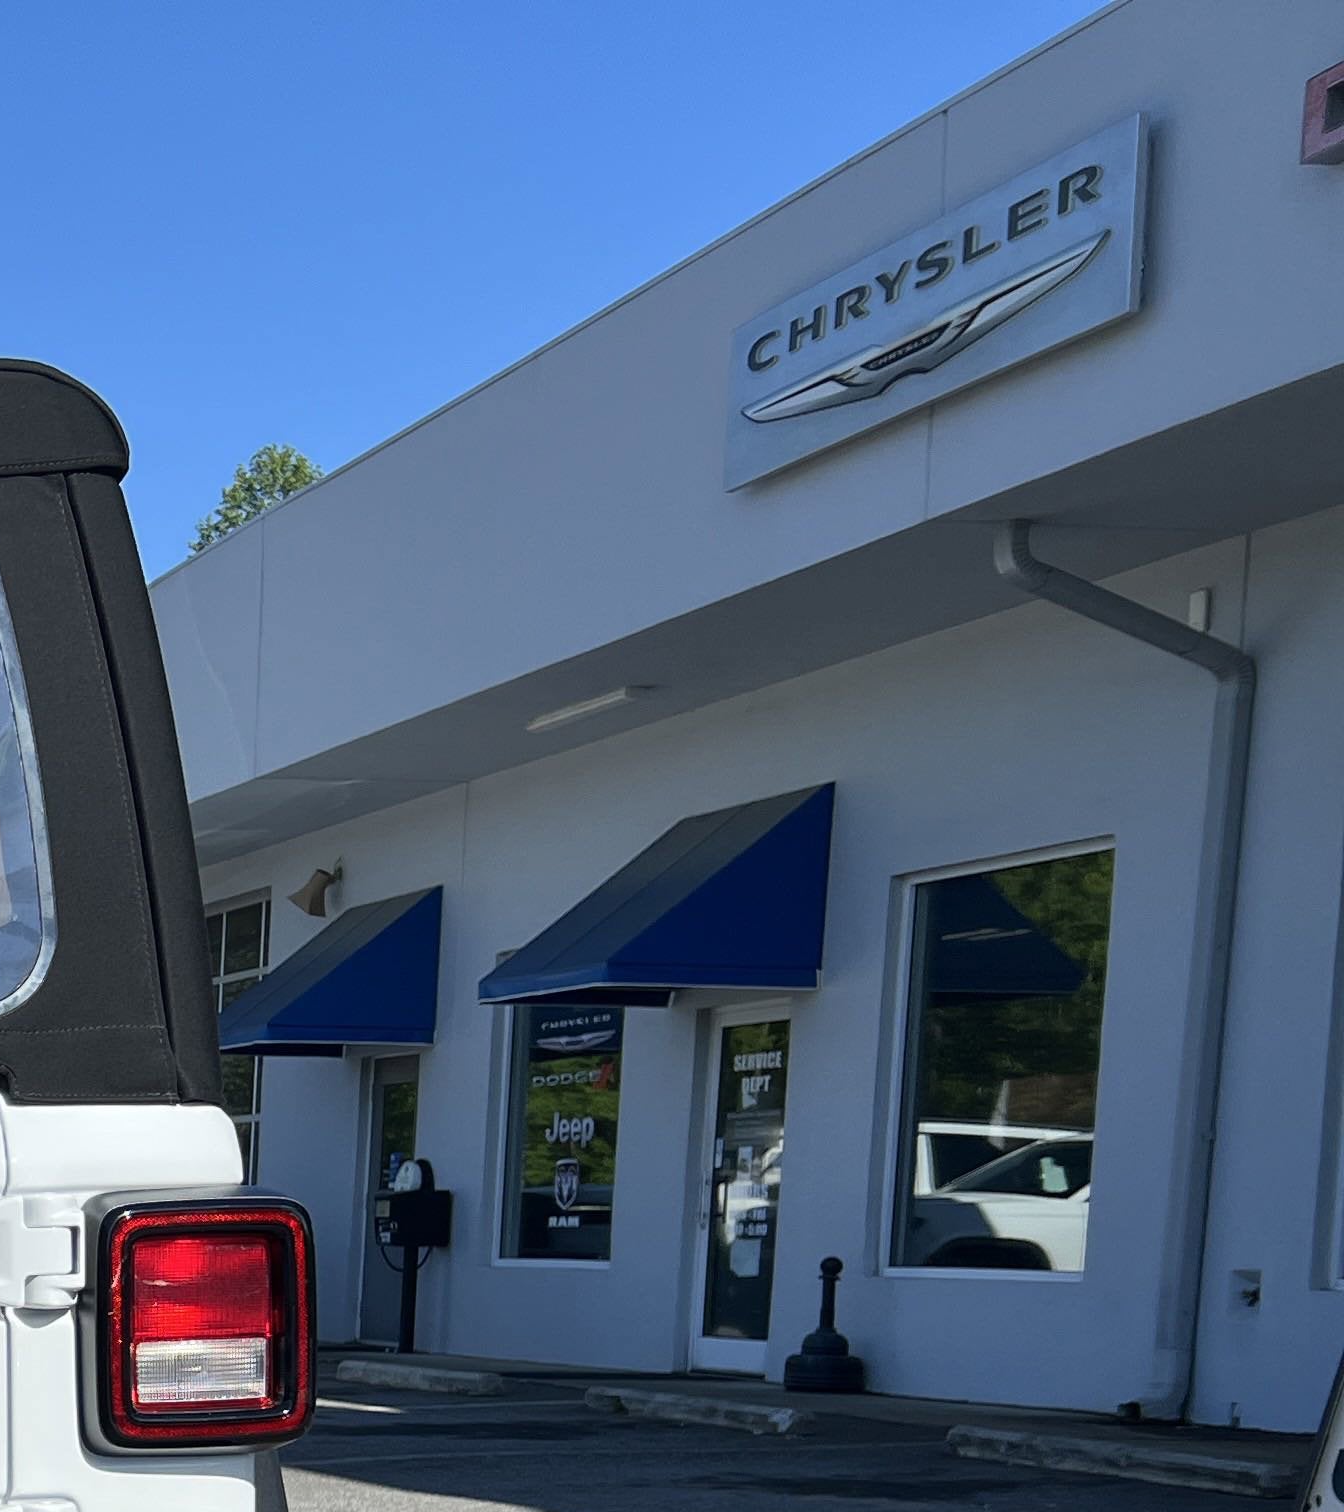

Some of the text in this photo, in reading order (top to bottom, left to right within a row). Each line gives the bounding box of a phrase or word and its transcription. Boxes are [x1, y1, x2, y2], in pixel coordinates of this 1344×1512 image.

[746, 164, 1104, 373] CHRYSLER
[734, 1051, 782, 1071] SERVICE
[532, 1070, 602, 1089] DODGE
[742, 1075, 771, 1095] DEPT
[546, 1113, 594, 1147] Jeep
[548, 1216, 580, 1228] RAM
